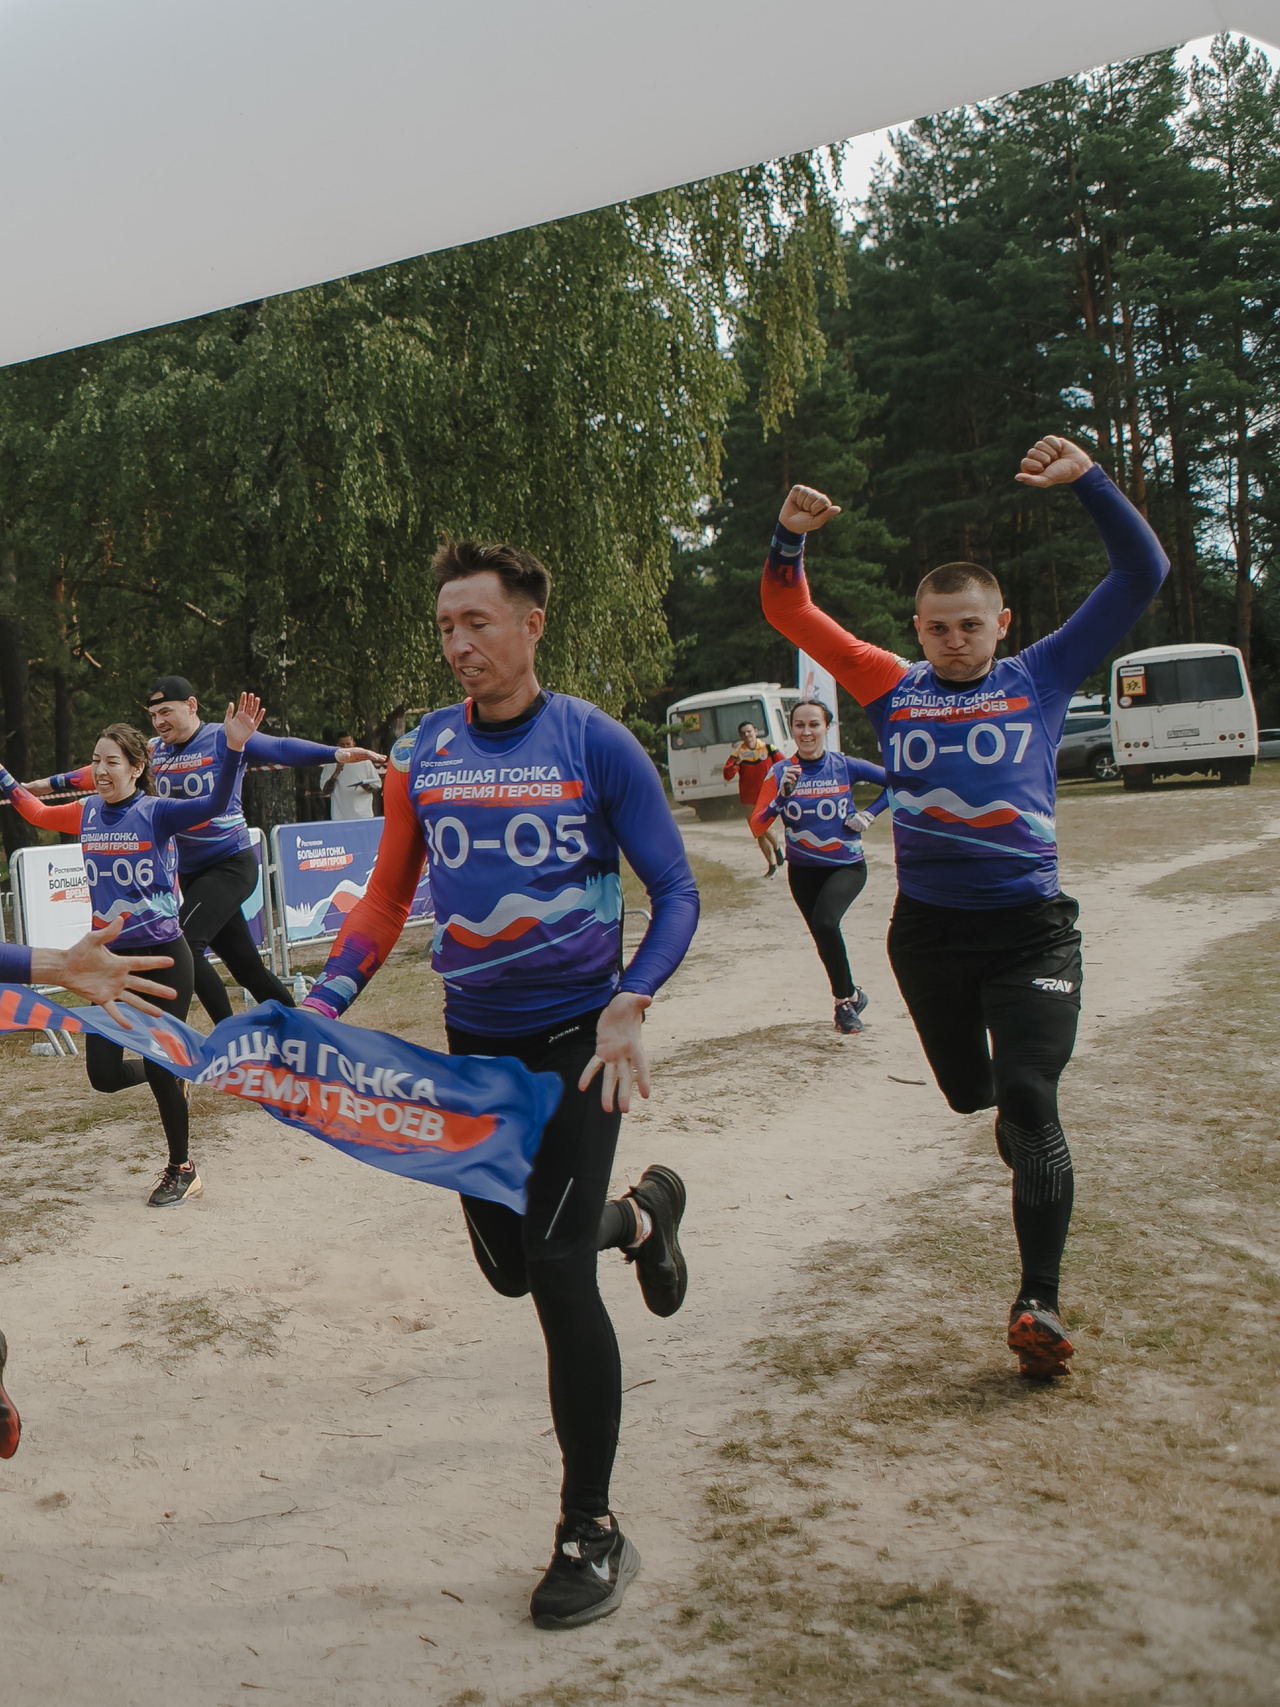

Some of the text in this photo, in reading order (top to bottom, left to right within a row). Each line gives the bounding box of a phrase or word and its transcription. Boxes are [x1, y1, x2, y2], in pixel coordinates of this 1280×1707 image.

[891, 689, 1006, 708] БОЛЬШАЯ ГОНКА
[910, 701, 1009, 718] ВРЕМЯ ГЕРОЕВ
[889, 722, 1033, 772] 10-07
[421, 758, 463, 768] Ростелеком
[414, 766, 561, 790] БОЛЬШАЯ ГОНКА
[442, 784, 563, 800] ВРЕМЯ ГЕРОЕВ
[110, 832, 139, 841] ГОНКА
[424, 813, 589, 869] 10-05
[87, 842, 140, 851] ВРЕМЯ ГЕРОЕВ
[297, 846, 346, 860] БОЛЬШАЯ ГОНКА
[54, 866, 84, 874] Ростелеком
[310, 858, 327, 868] ВРЕМЯ
[85, 858, 154, 887] 0-06
[49, 875, 88, 890] БОЛЬШАЯ
[195, 1031, 439, 1107] ЛЬШАЯ ГОНКА
[218, 1067, 445, 1142] РЕМЯ ГЕРОЕВ
